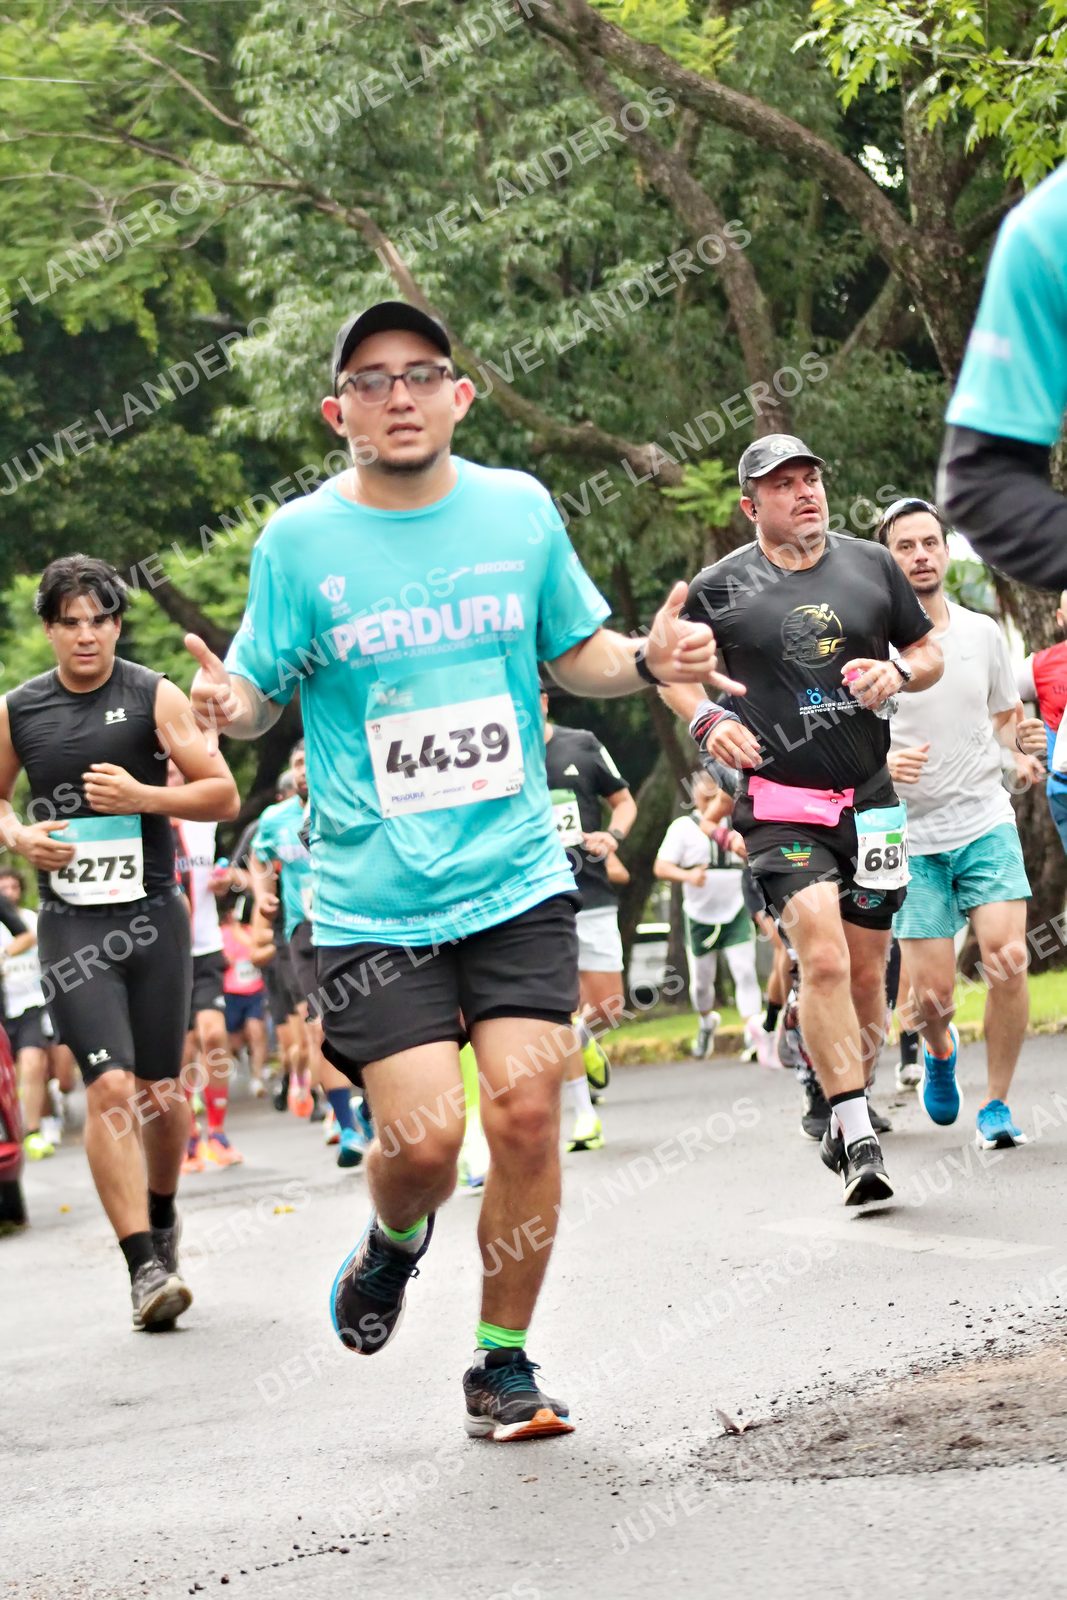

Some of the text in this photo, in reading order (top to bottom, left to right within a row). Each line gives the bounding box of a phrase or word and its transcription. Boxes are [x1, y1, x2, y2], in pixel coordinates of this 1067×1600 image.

[474, 560, 525, 576] BROOKS
[333, 593, 525, 662] PERDURA
[386, 722, 510, 779] 4439
[57, 854, 137, 884] 4273
